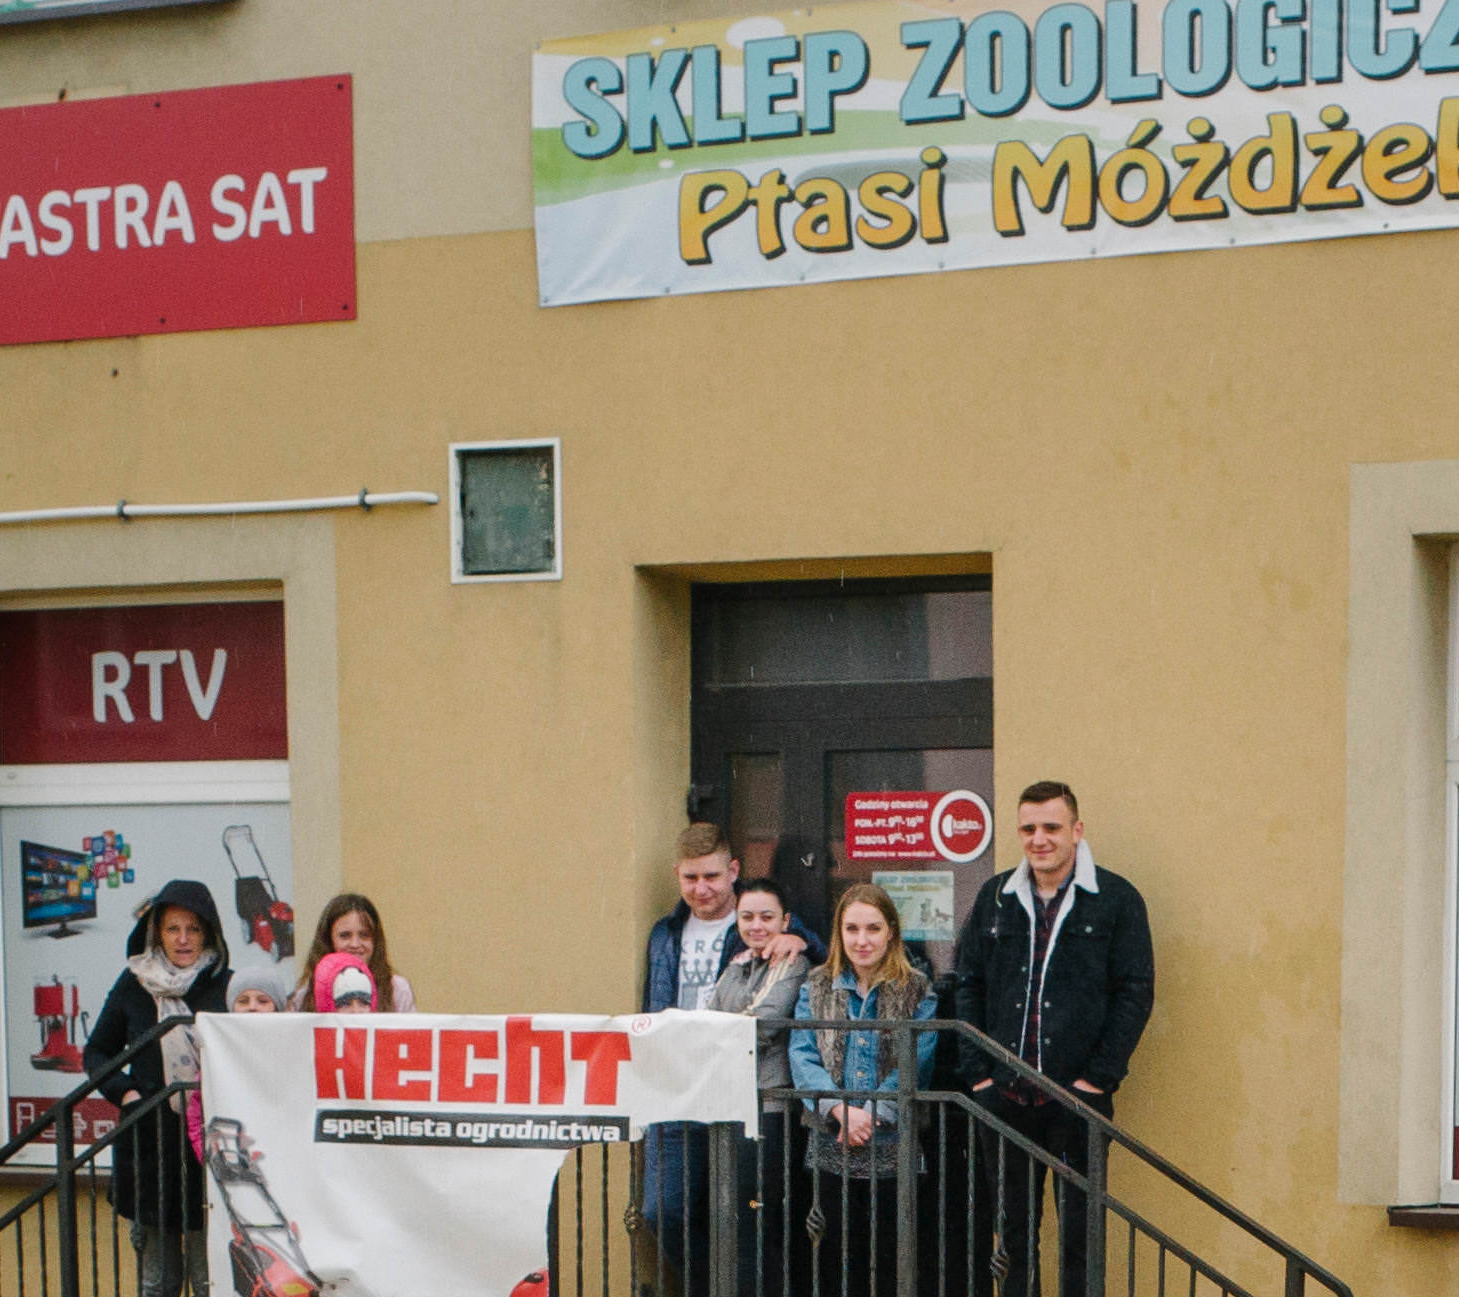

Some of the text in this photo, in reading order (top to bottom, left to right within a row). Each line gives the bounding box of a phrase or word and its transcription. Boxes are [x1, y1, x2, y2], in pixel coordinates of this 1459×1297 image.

[560, 30, 871, 162] SKLEP
[211, 167, 328, 242] SAT
[677, 146, 950, 265] Ptasi
[92, 648, 228, 724] RTV
[322, 1115, 621, 1144] specjalista ogrodnictwa
